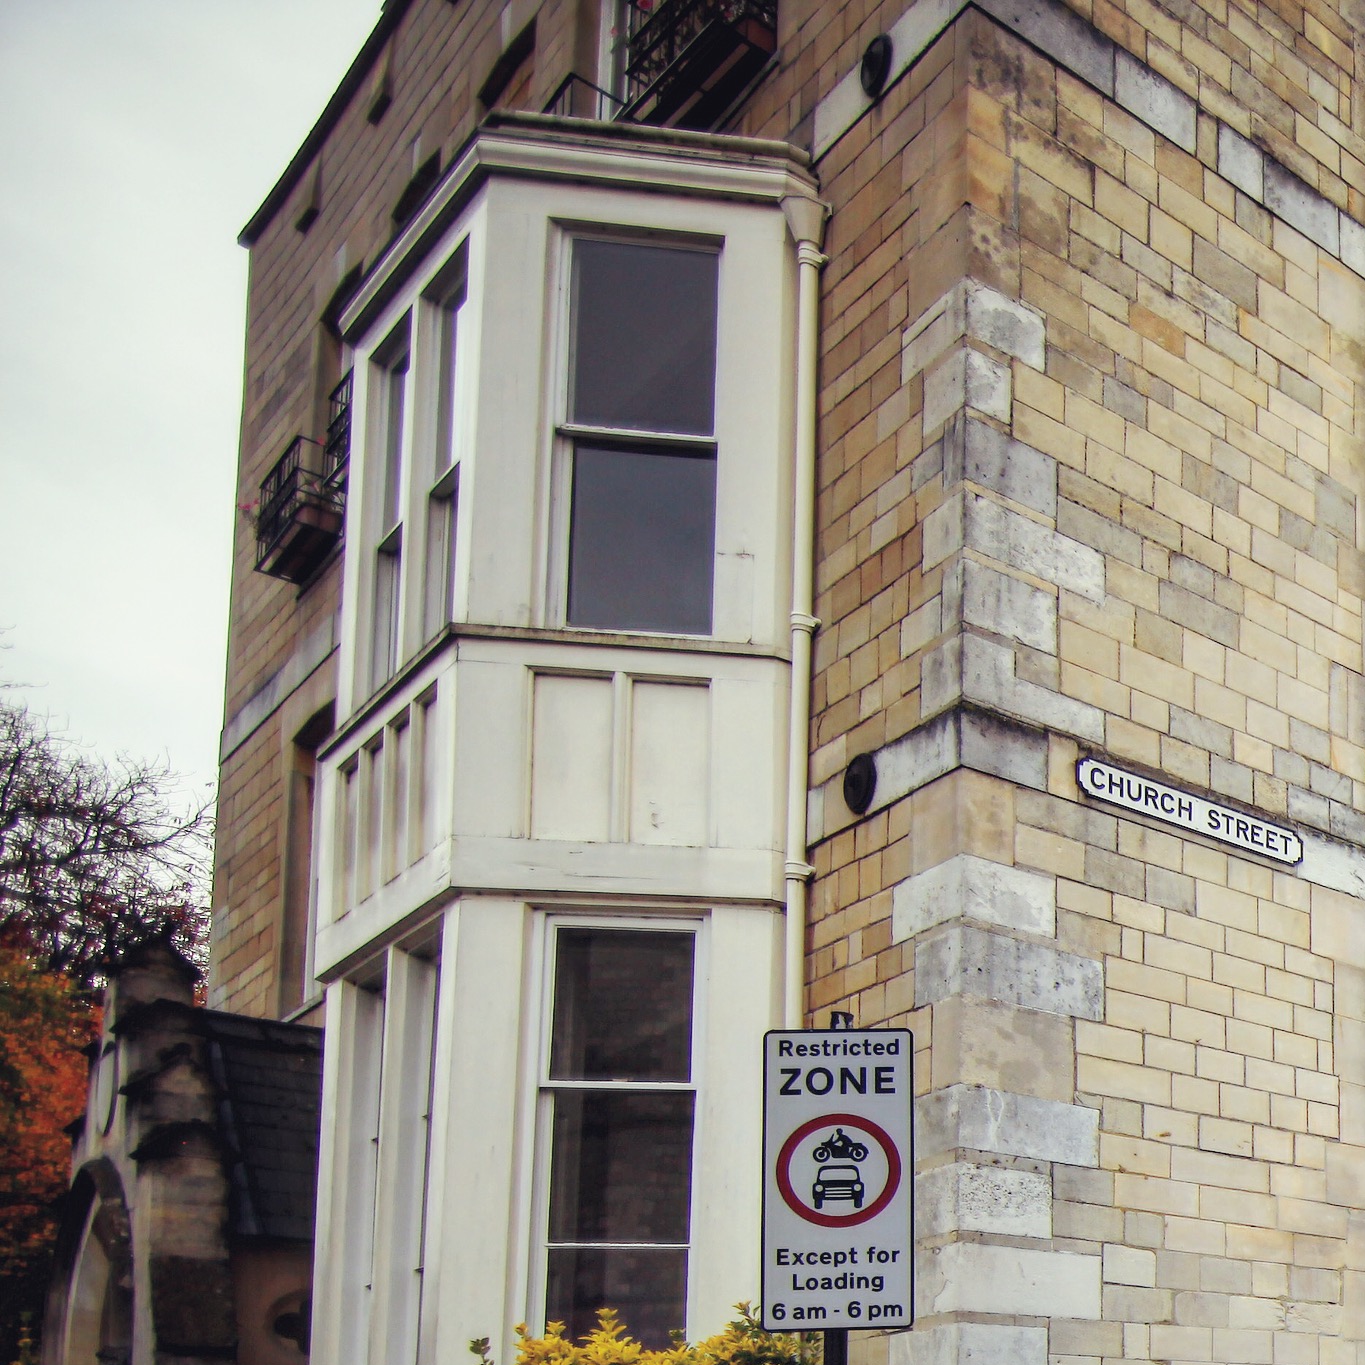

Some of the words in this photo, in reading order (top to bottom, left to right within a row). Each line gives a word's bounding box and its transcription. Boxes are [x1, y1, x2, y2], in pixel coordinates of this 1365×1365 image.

[1089, 767, 1193, 822] CHURCH
[1207, 808, 1293, 855] STREET
[778, 1038, 900, 1057] Restricted
[779, 1066, 896, 1096] ZONE
[776, 1248, 858, 1268] Except
[867, 1247, 900, 1264] for
[792, 1272, 885, 1292] Loading
[772, 1303, 786, 1321] 6
[792, 1305, 827, 1320] am
[847, 1301, 861, 1319] 6
[868, 1302, 903, 1321] pm
